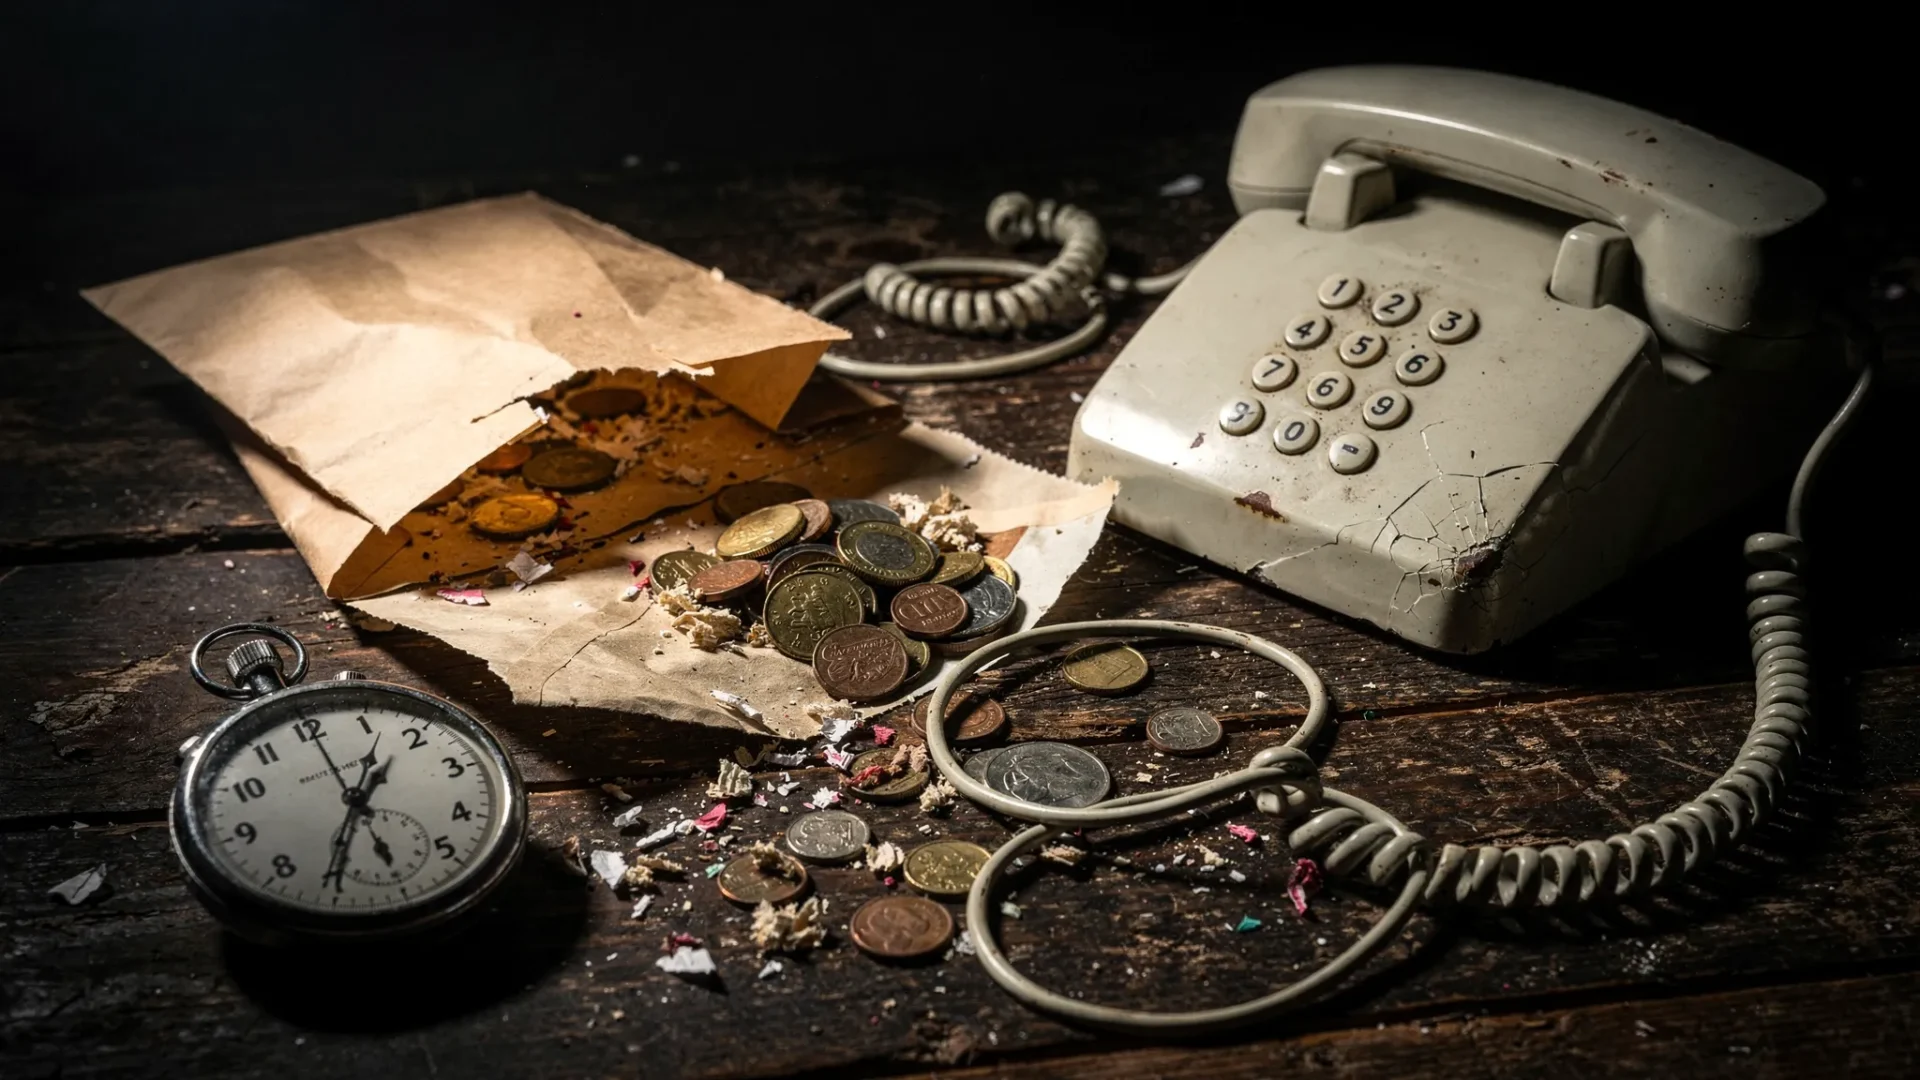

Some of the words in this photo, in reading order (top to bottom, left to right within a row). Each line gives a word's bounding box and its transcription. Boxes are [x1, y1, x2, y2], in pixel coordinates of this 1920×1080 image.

[1332, 278, 1348, 297] 1
[1380, 294, 1404, 314] 2
[1439, 311, 1462, 331] 3
[1295, 320, 1316, 339] 4
[1350, 337, 1373, 355] 5
[1405, 355, 1428, 373] 6
[1262, 359, 1284, 378] 7
[1316, 378, 1338, 396] 6
[1371, 396, 1394, 415] 9
[1284, 421, 1304, 441] 0
[292, 718, 327, 743] 12
[356, 716, 372, 734] 1
[402, 728, 427, 751] 2
[253, 742, 279, 765] 11
[442, 757, 464, 778] 3
[233, 778, 266, 802] 10
[452, 801, 472, 823] 4
[235, 821, 258, 844] 9
[434, 836, 455, 859] 5
[272, 855, 297, 878] 8
